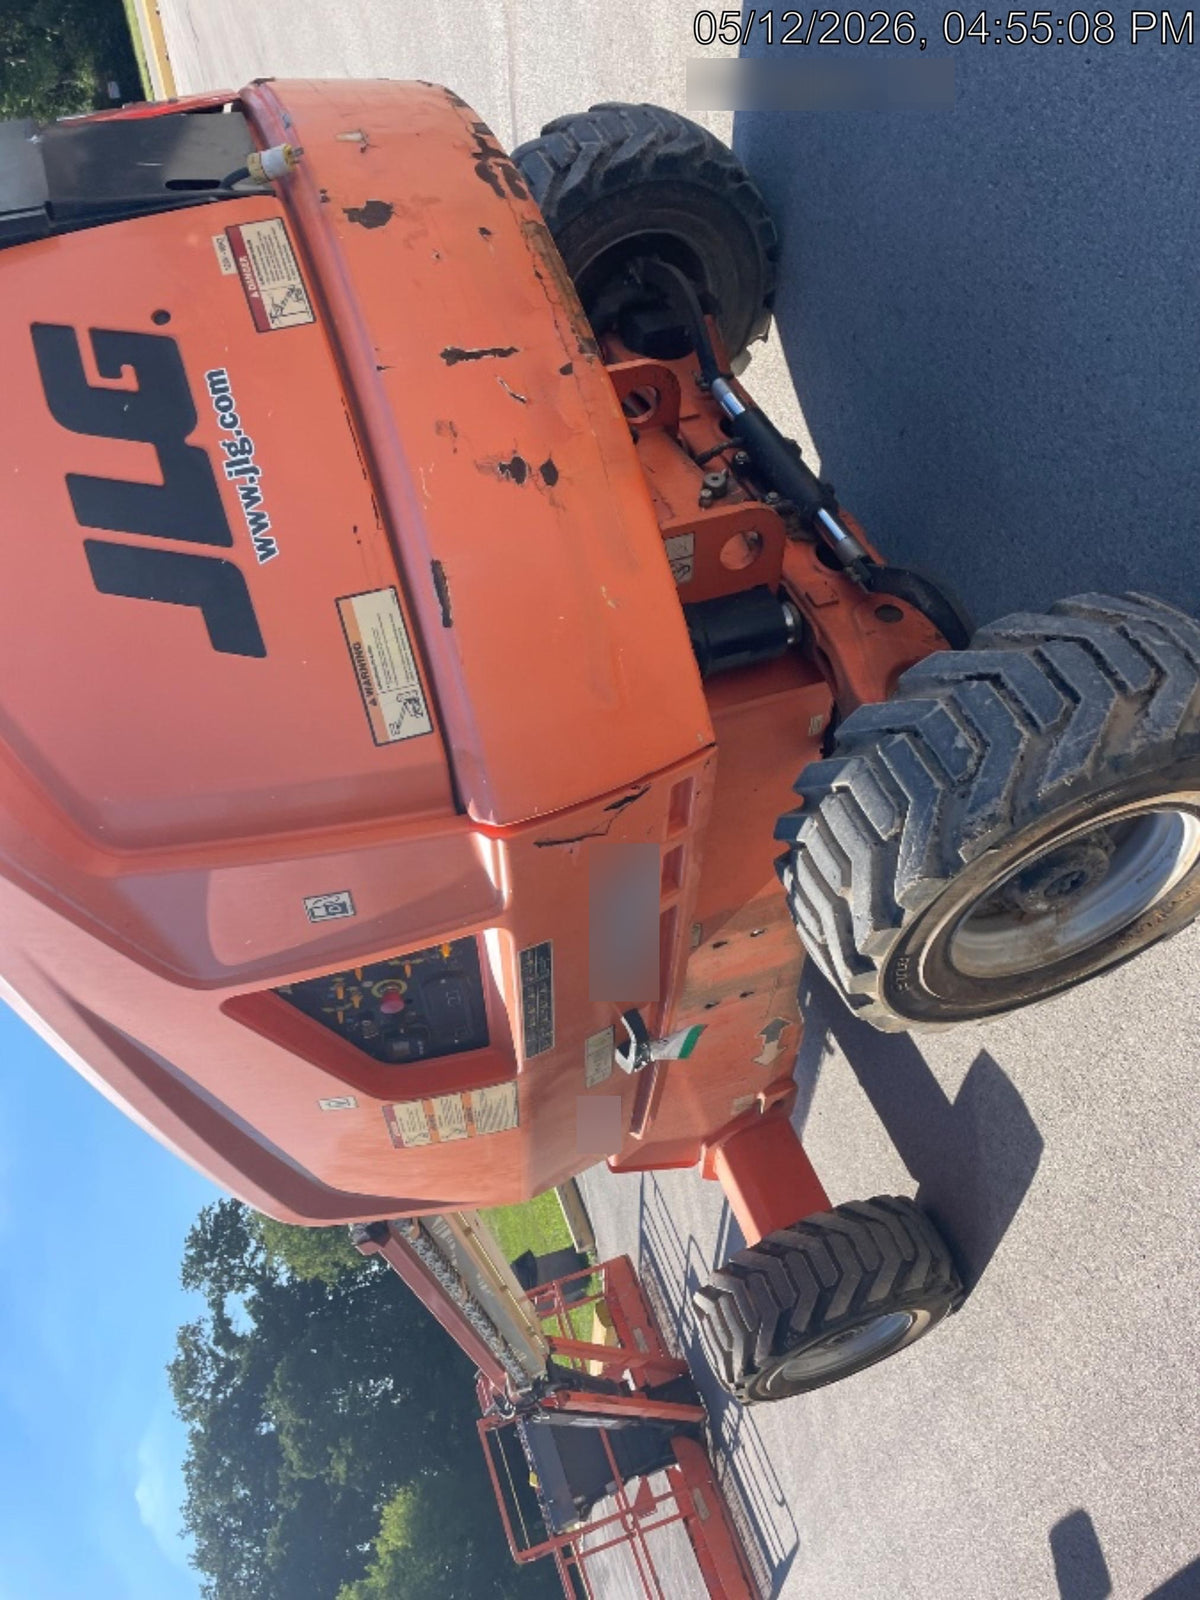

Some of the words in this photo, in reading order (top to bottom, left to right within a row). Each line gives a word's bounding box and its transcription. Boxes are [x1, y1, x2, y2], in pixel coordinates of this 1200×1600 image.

[240, 255, 257, 290] DANGER
[30, 321, 267, 659] JLG
[204, 367, 279, 565] www.jlg.com
[352, 641, 374, 697] WARNING
